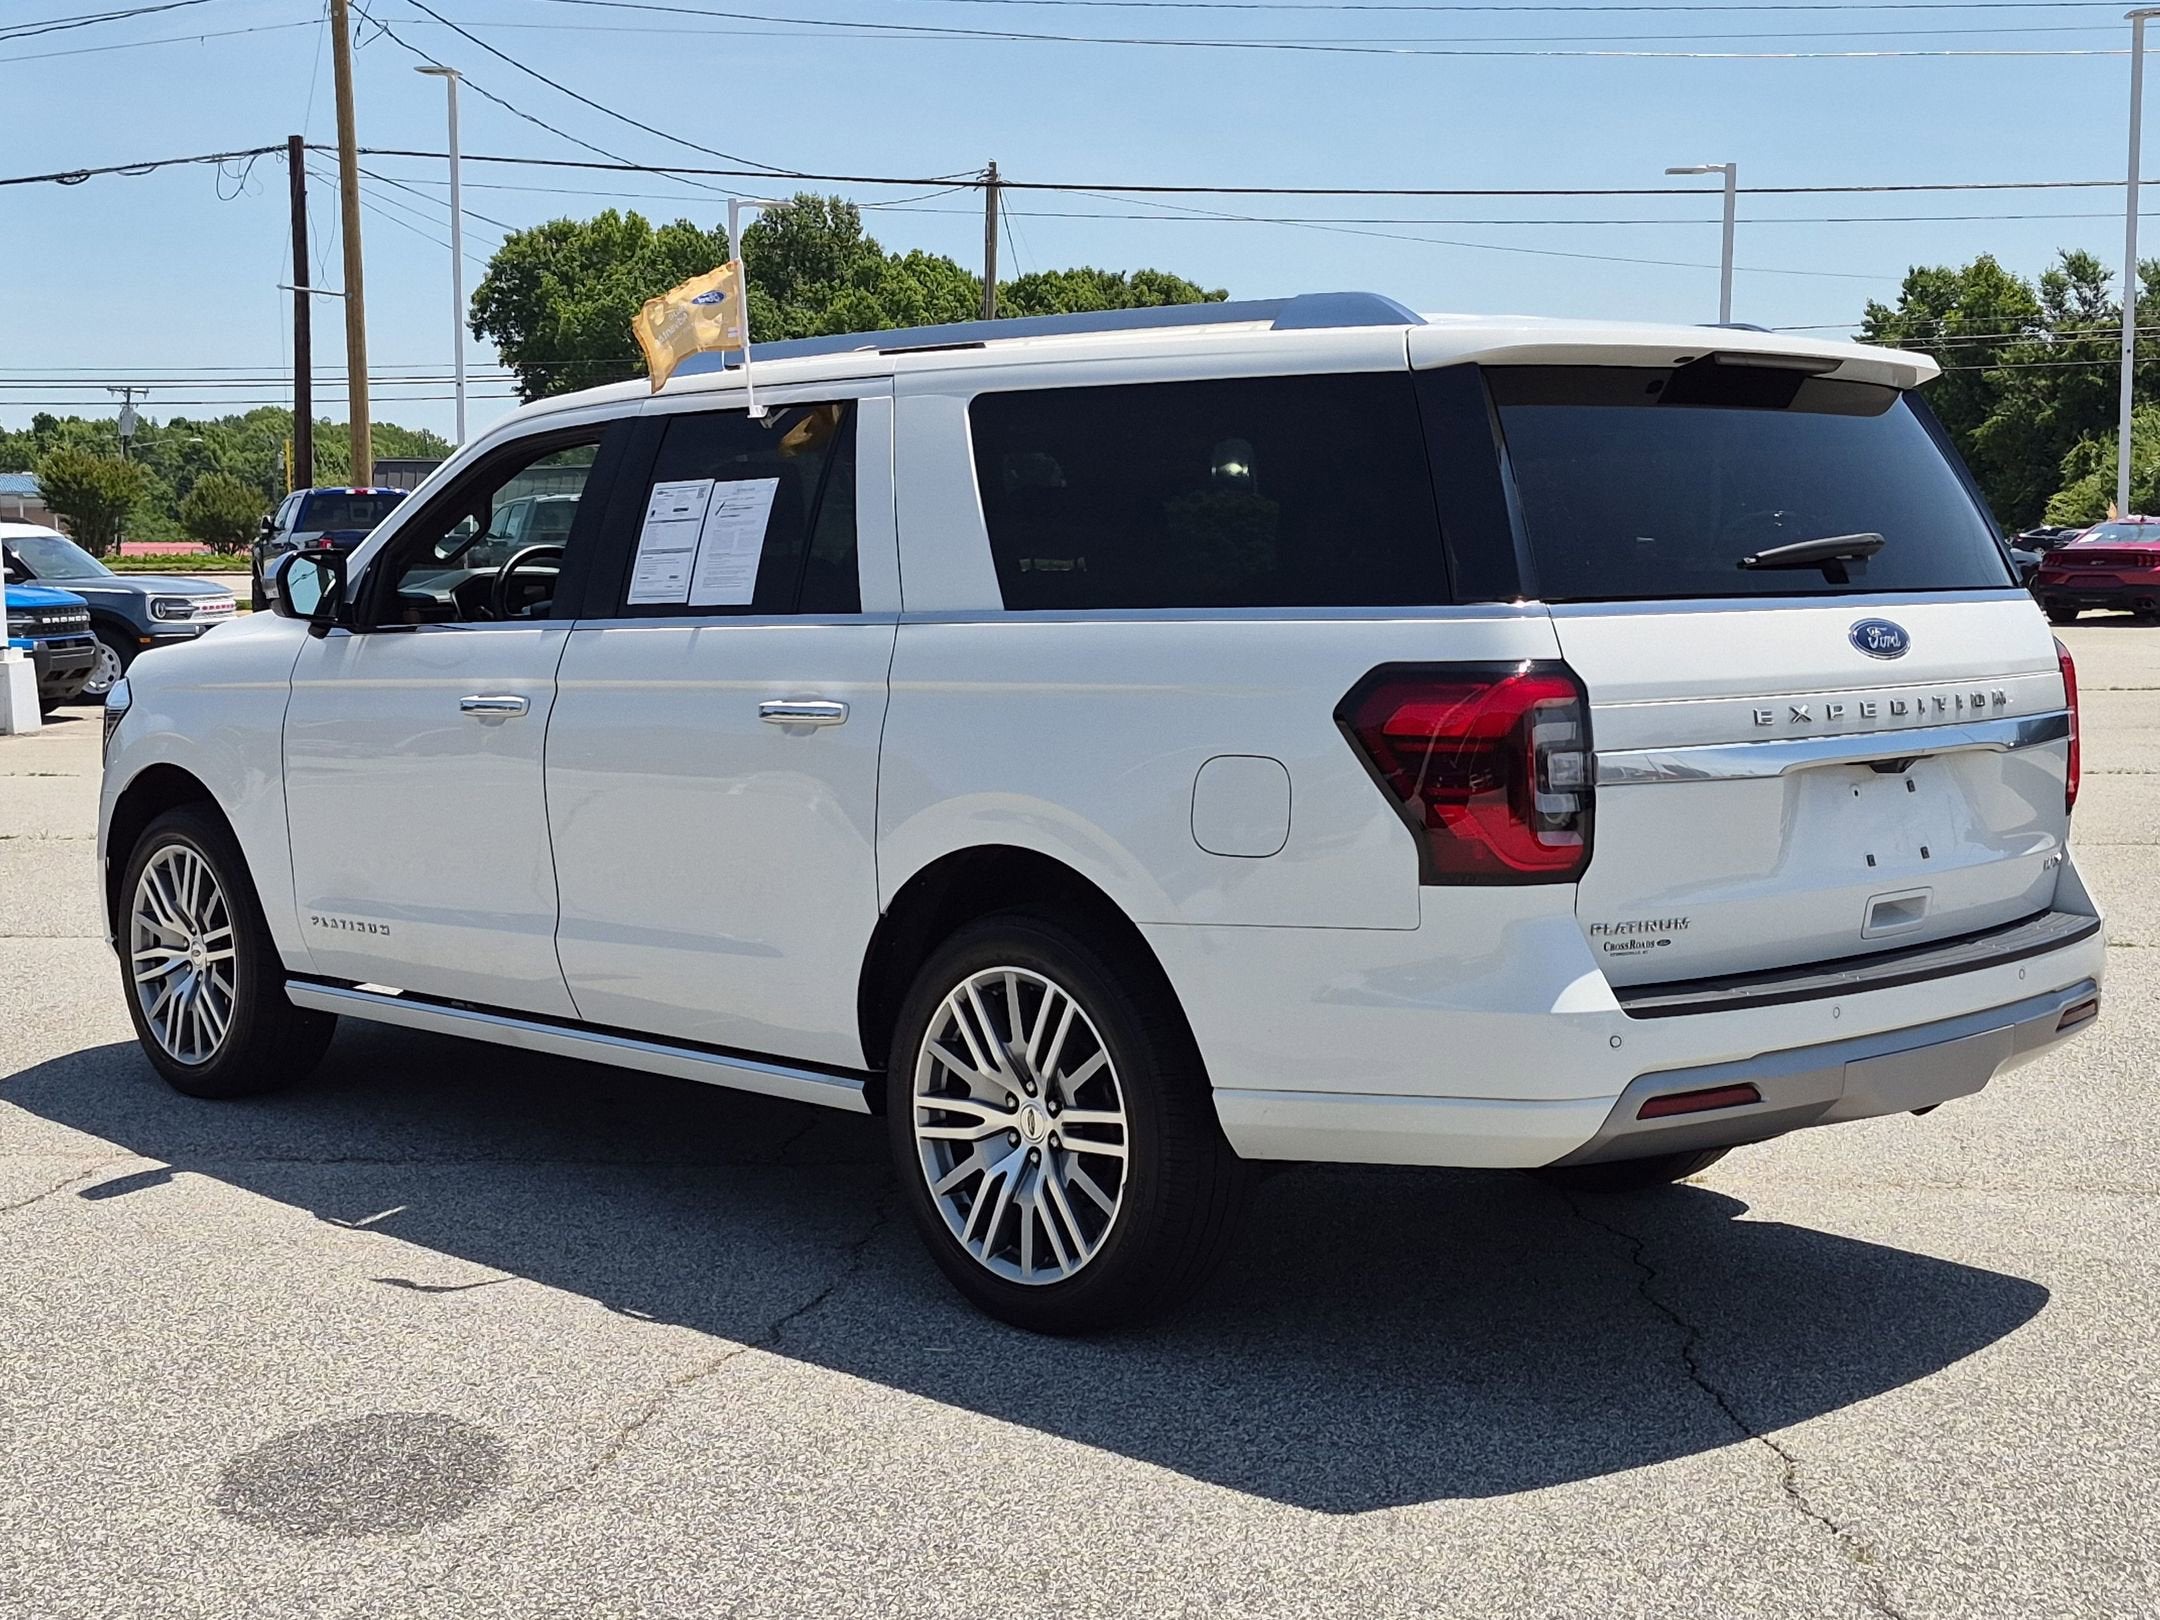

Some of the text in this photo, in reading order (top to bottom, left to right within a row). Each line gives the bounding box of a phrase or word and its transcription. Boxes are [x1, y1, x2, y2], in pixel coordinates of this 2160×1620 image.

[41, 615, 88, 625] BRONCO
[1753, 688, 2007, 726] EXPEDITION
[311, 915, 390, 936] PLATINUM
[1590, 917, 1690, 936] PLATINUM
